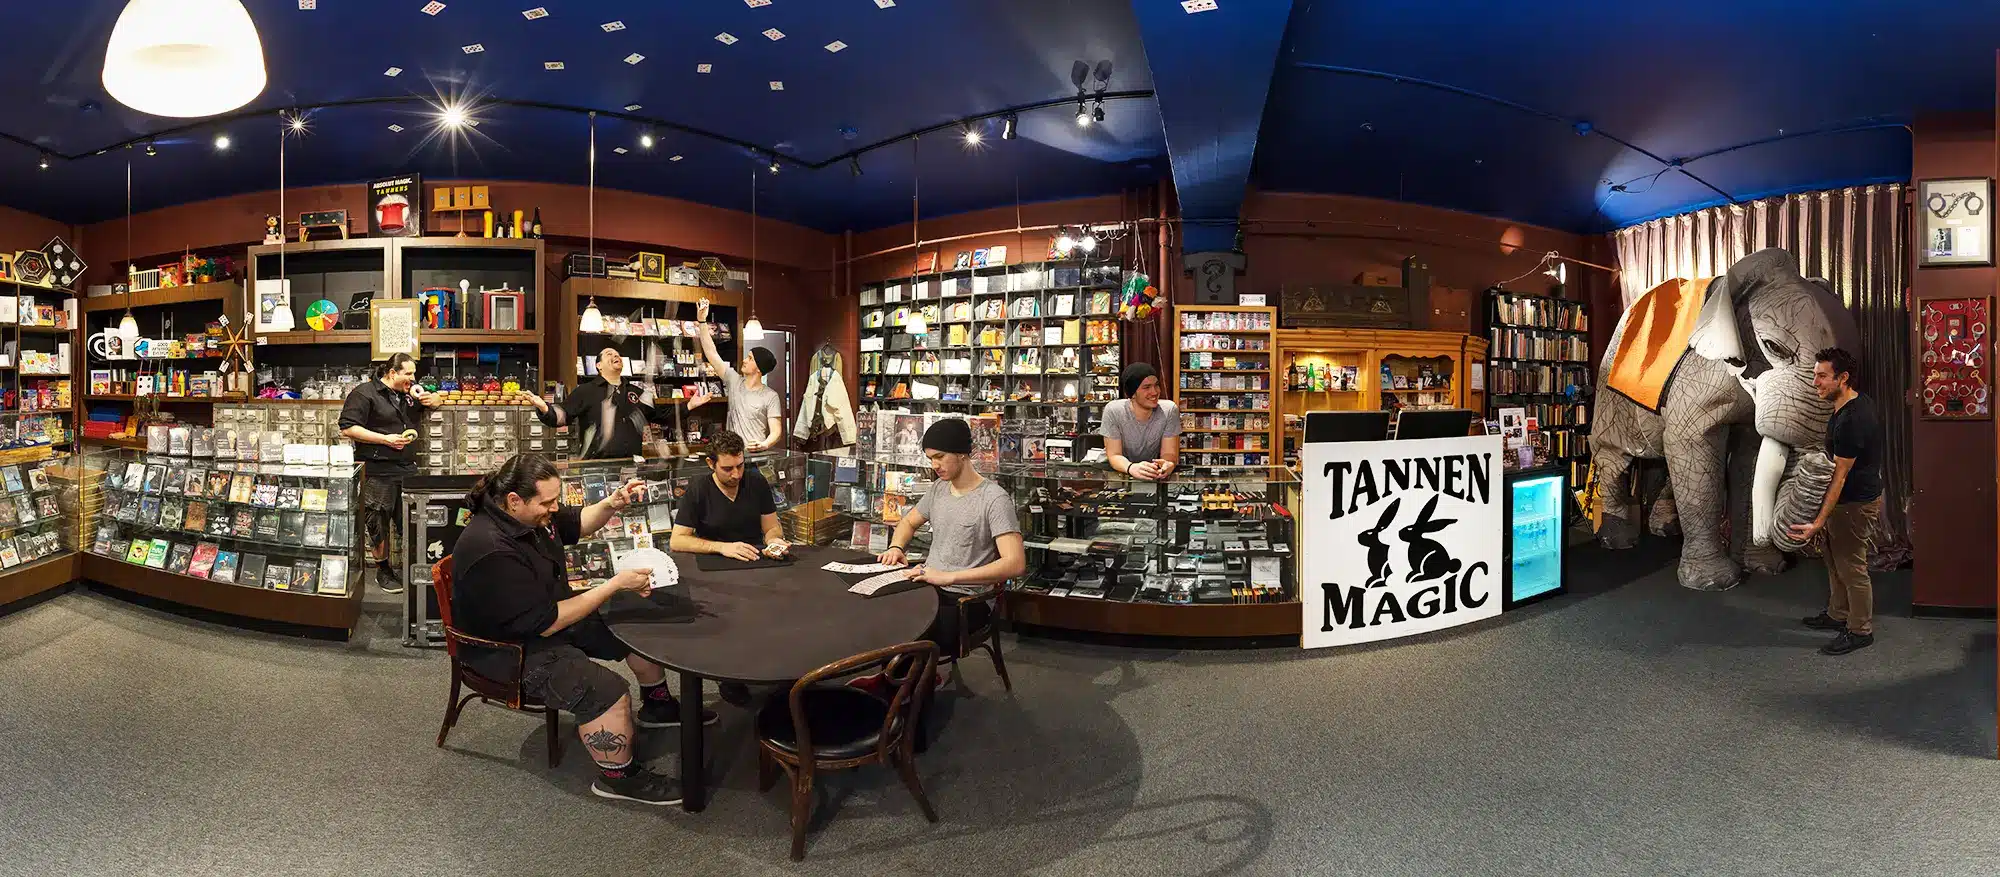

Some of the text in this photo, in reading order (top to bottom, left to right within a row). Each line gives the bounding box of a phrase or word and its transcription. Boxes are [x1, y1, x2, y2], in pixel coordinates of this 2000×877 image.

[281, 487, 297, 496] ACE
[1323, 452, 1492, 520] TANNEN
[1320, 561, 1489, 632] MAGIC
